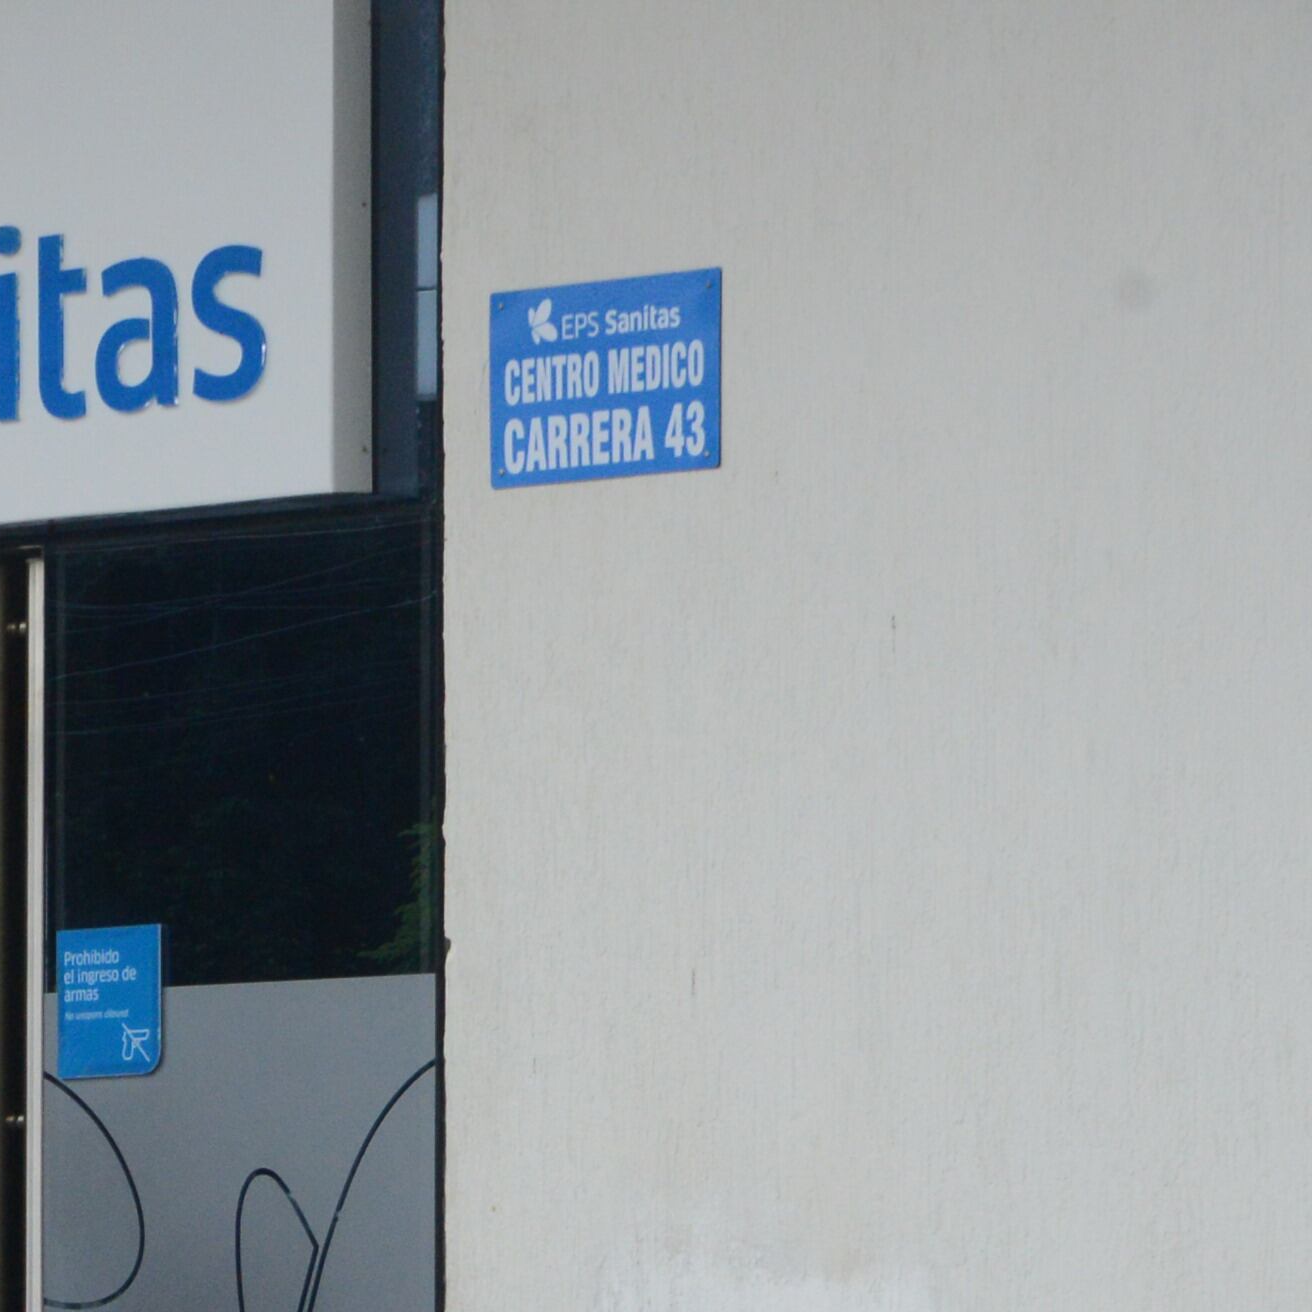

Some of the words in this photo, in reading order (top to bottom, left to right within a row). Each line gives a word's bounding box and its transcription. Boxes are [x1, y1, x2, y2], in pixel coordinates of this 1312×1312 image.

[561, 312, 599, 340] EPS
[605, 304, 681, 335] Sanitas
[504, 350, 600, 406] CENTRO
[607, 339, 705, 395] MEDICO
[503, 406, 655, 475] CARRERA
[664, 400, 706, 457] 43
[63, 950, 120, 966] Prohibido
[63, 969, 74, 984] el
[77, 968, 119, 985] ingreso
[121, 966, 137, 981] de
[63, 988, 100, 1003] armas
